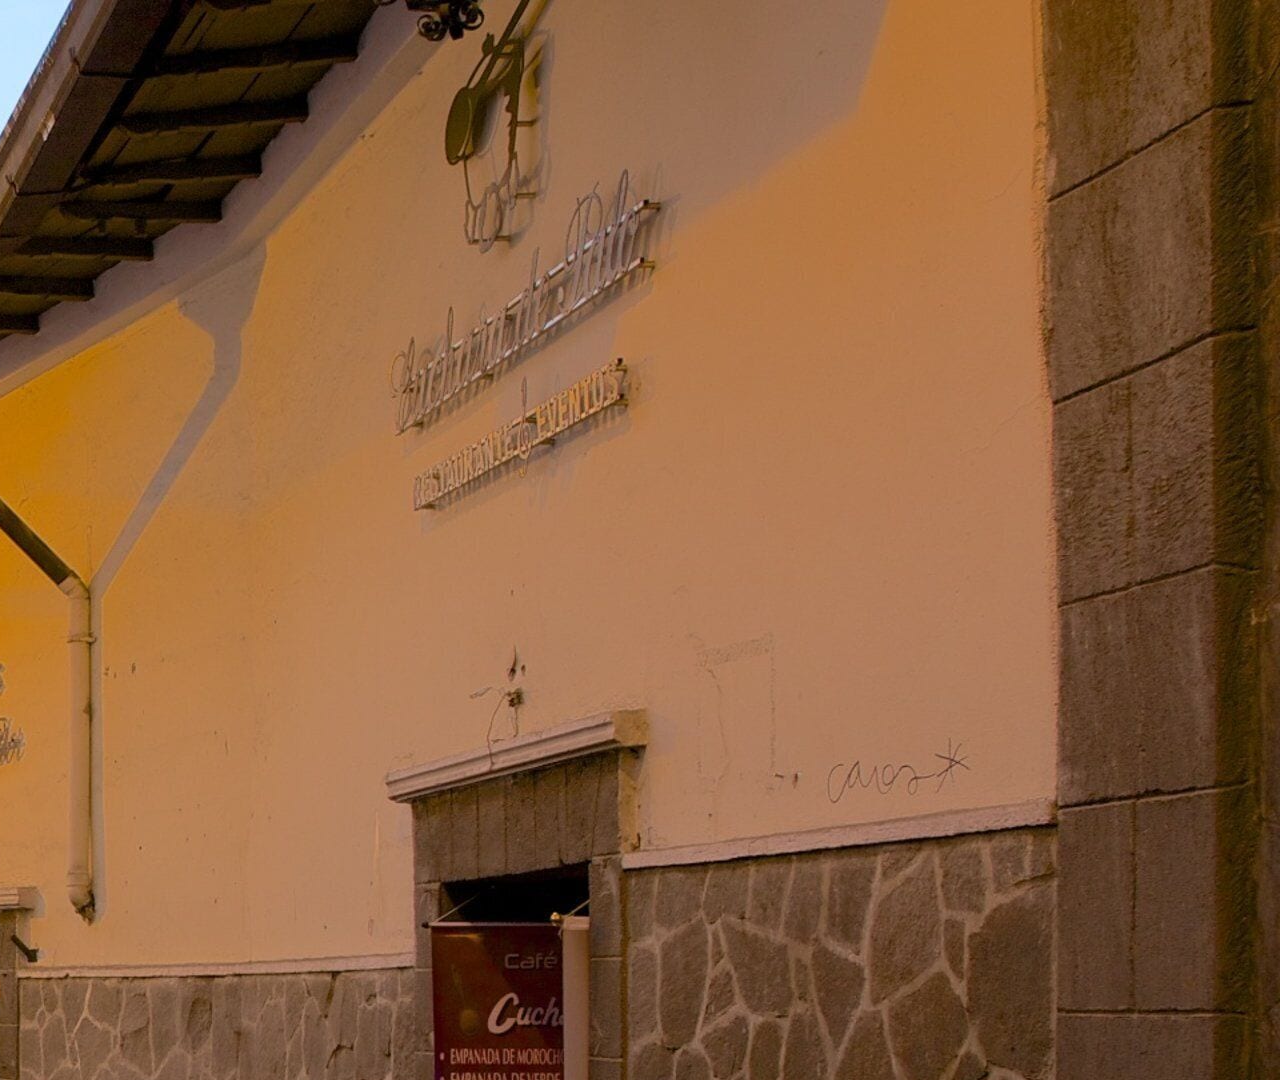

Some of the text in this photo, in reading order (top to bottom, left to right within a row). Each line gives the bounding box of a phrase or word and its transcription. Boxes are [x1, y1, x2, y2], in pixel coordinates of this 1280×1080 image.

[414, 364, 622, 511] RESTAURANTE EVENTOS
[504, 950, 559, 970] Café
[450, 1048, 501, 1066] EMPANADA
[502, 1048, 515, 1065] DE
